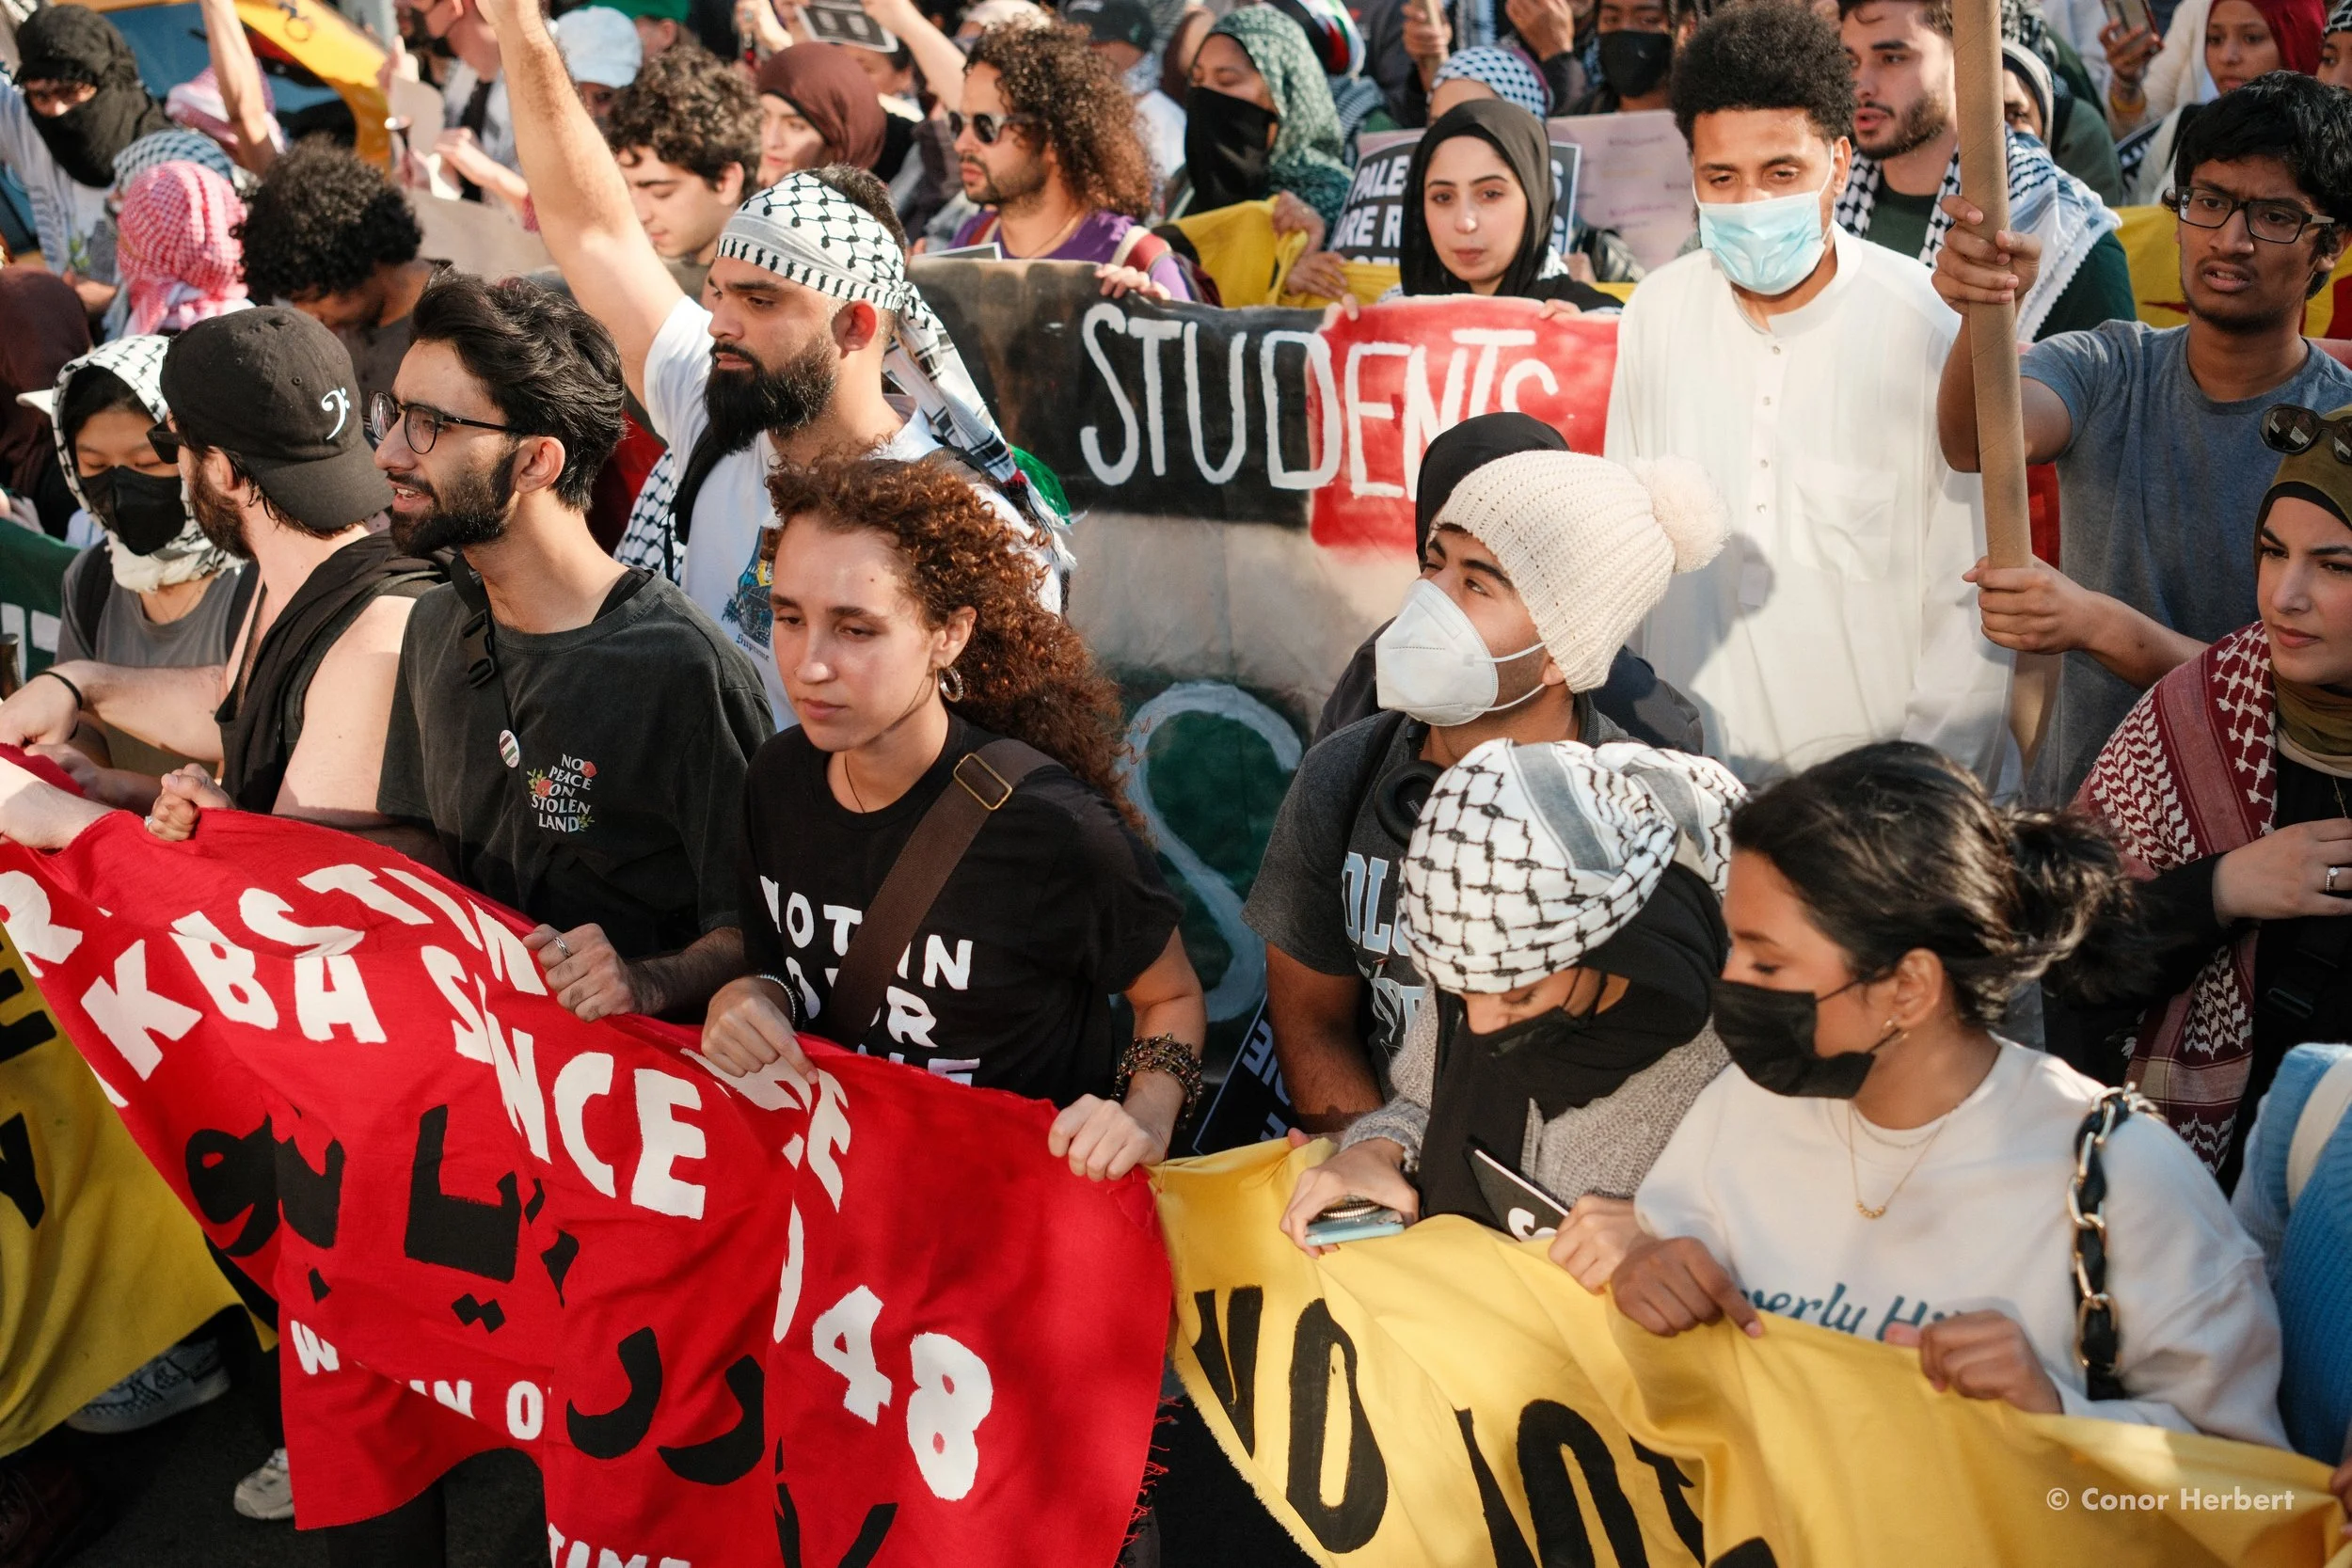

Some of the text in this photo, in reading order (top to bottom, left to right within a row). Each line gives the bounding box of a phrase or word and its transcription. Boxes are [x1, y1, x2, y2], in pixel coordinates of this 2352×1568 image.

[1350, 155, 1410, 205] PALE
[1080, 303, 1559, 502] STUDENTS
[548, 765, 593, 791] PEACE
[562, 753, 583, 771] NO
[531, 794, 592, 815] STOLEN
[548, 784, 576, 798] ON
[538, 813, 580, 832] LAND
[80, 901, 389, 1108] KBA
[785, 956, 939, 1049] OR
[1740, 1283, 1868, 1335] verly
[811, 1284, 993, 1502] 48
